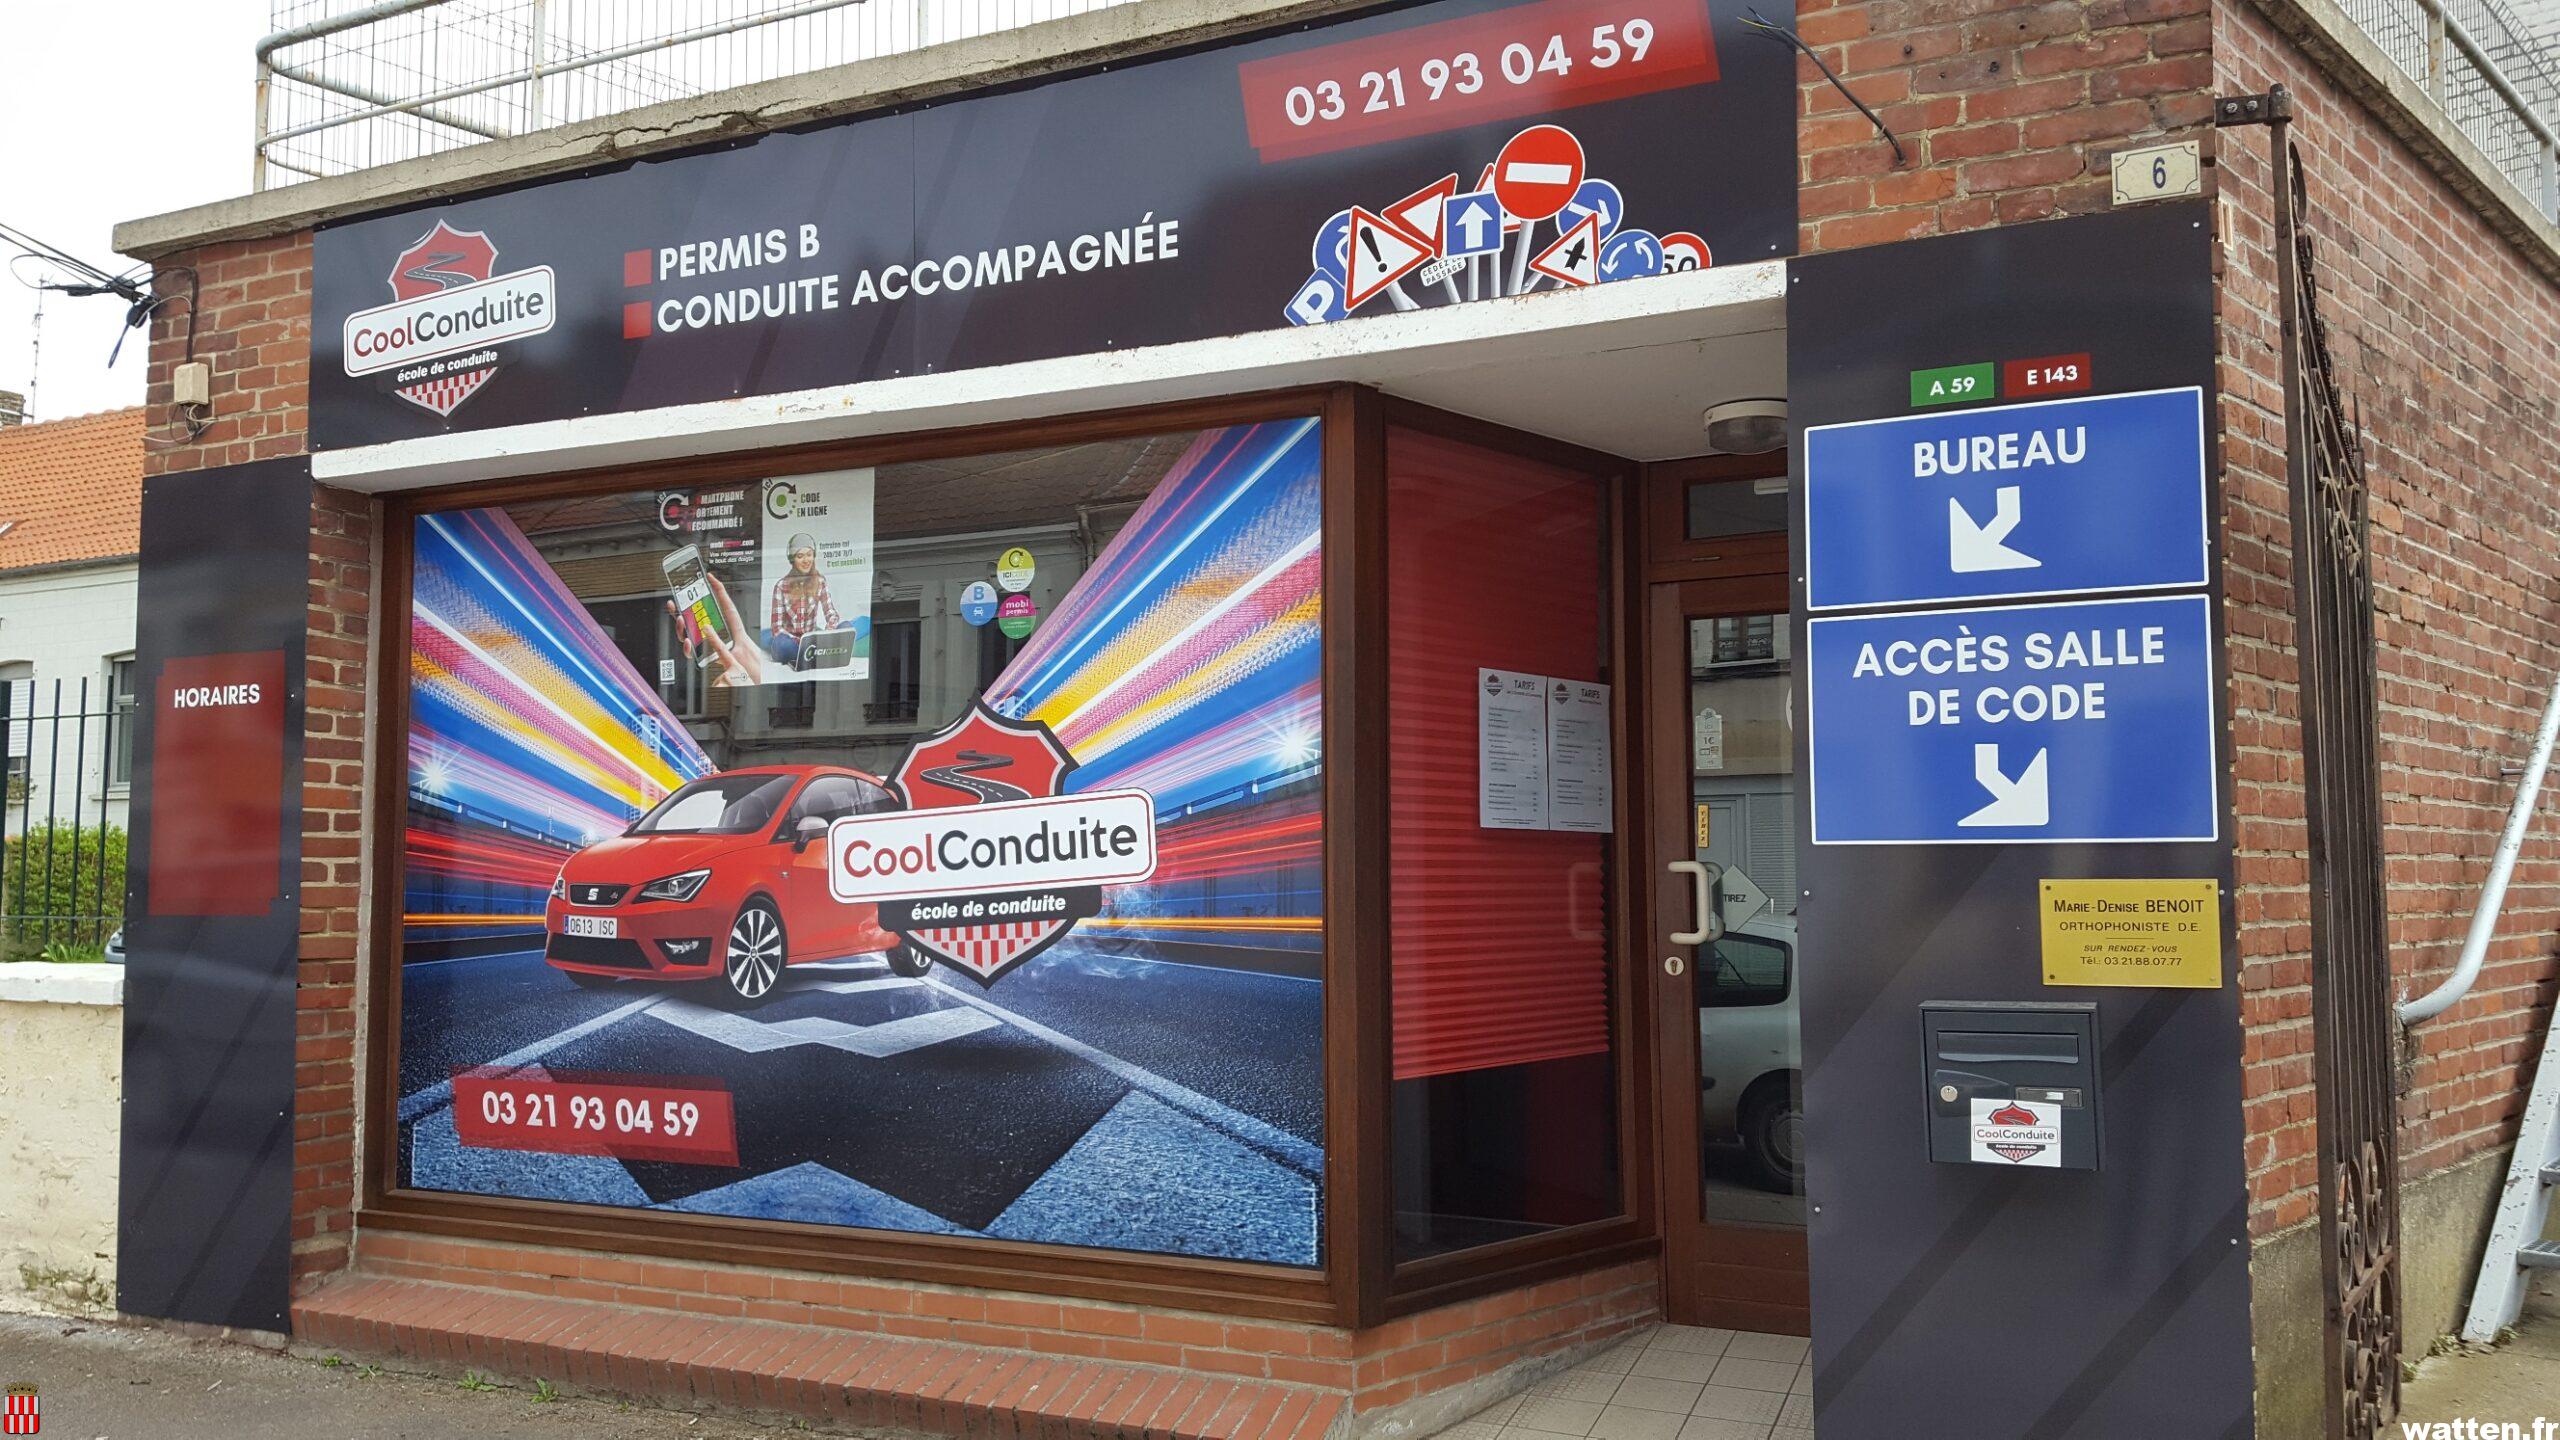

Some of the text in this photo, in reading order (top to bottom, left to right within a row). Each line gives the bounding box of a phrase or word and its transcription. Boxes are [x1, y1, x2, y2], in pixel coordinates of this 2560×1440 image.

[1285, 18, 1654, 126] 03 21 93 04 59
[2153, 156, 2166, 189] 6
[659, 223, 820, 281] PERMIS B
[657, 211, 1179, 332] CONDUITE ACCOMPAGNÉE
[1426, 262, 1463, 284] PASSAGE
[353, 289, 544, 358] CoolConduite
[397, 350, 498, 383] école de conduite
[2027, 365, 2078, 387] E 143
[1930, 377, 1975, 397] A 59
[1913, 426, 2087, 478] BUREAU
[800, 492, 820, 504] CODE
[796, 505, 828, 517] EN LIGNE
[687, 586, 699, 601] 01
[974, 586, 984, 601] B
[1006, 600, 1028, 608] mobi
[1852, 625, 2165, 679] ACCÈS SALLE
[174, 683, 260, 709] HORAIRES
[1514, 680, 1535, 691] TARIFS
[1581, 688, 1600, 699] TARIFS
[1908, 682, 2106, 726] DE CODE
[843, 816, 1138, 878] CoolConduite
[911, 895, 1066, 921] école de conduite
[1723, 894, 1747, 903] TIREZ
[2145, 900, 2204, 913] BENOIT
[570, 917, 593, 935] 0613
[2059, 921, 2170, 932] ORTHOPHONISTE
[2083, 944, 2178, 953] SUR RENDEZ-VOUS
[2104, 956, 2182, 966] 03.21.88.07.77
[482, 1091, 699, 1137] 03 21 93 04 59
[1976, 1129, 2055, 1140] CoolConduite
